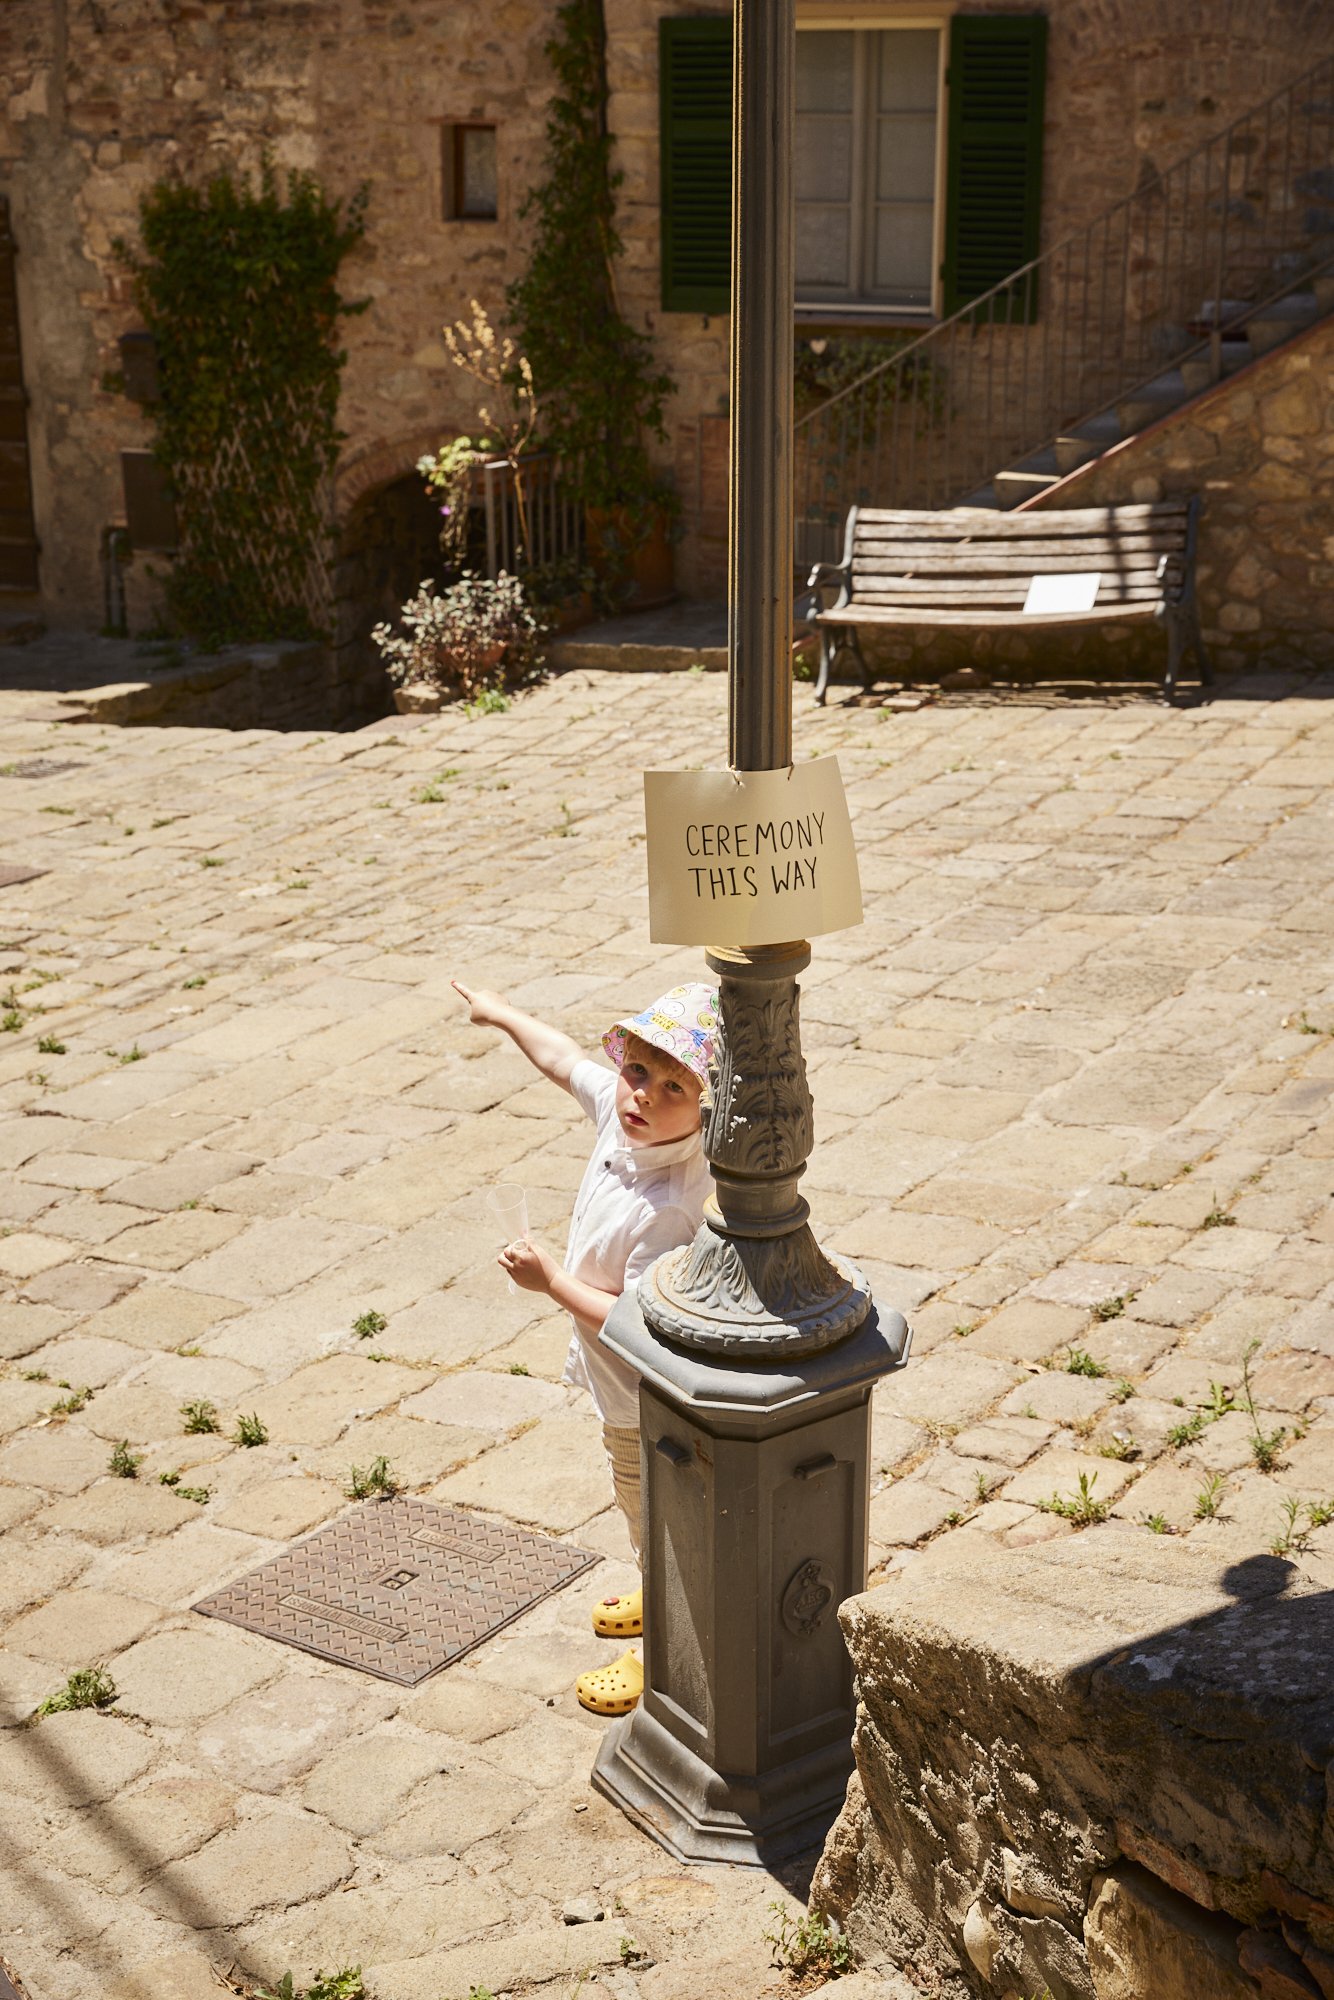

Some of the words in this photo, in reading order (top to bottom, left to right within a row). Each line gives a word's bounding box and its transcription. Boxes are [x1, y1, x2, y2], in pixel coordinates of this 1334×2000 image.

[686, 811, 825, 857] CEREMONY
[688, 865, 758, 900] THIS
[771, 856, 817, 894] WAY
[652, 1017, 671, 1030] WORLD
